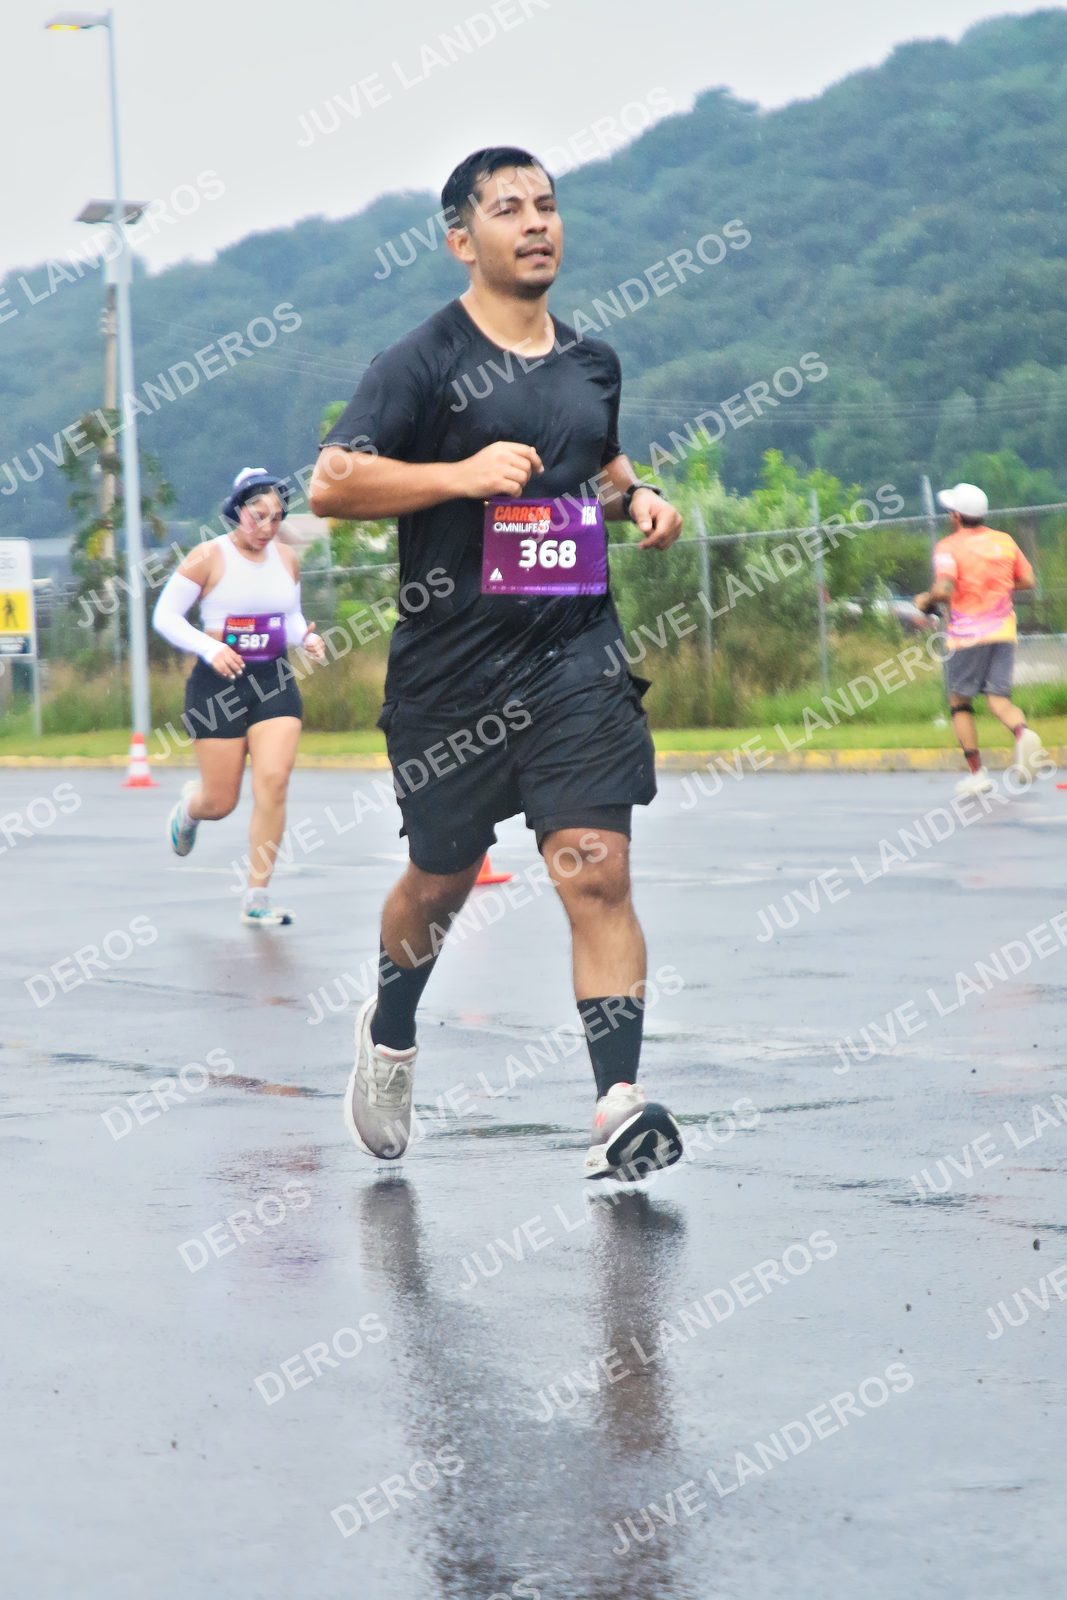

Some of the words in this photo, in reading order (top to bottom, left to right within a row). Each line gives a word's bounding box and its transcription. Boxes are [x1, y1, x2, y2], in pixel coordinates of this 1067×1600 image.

[494, 506, 552, 521] CARRERA
[493, 521, 540, 534] OMNILIFE
[519, 539, 577, 569] 368
[239, 633, 270, 650] 587
